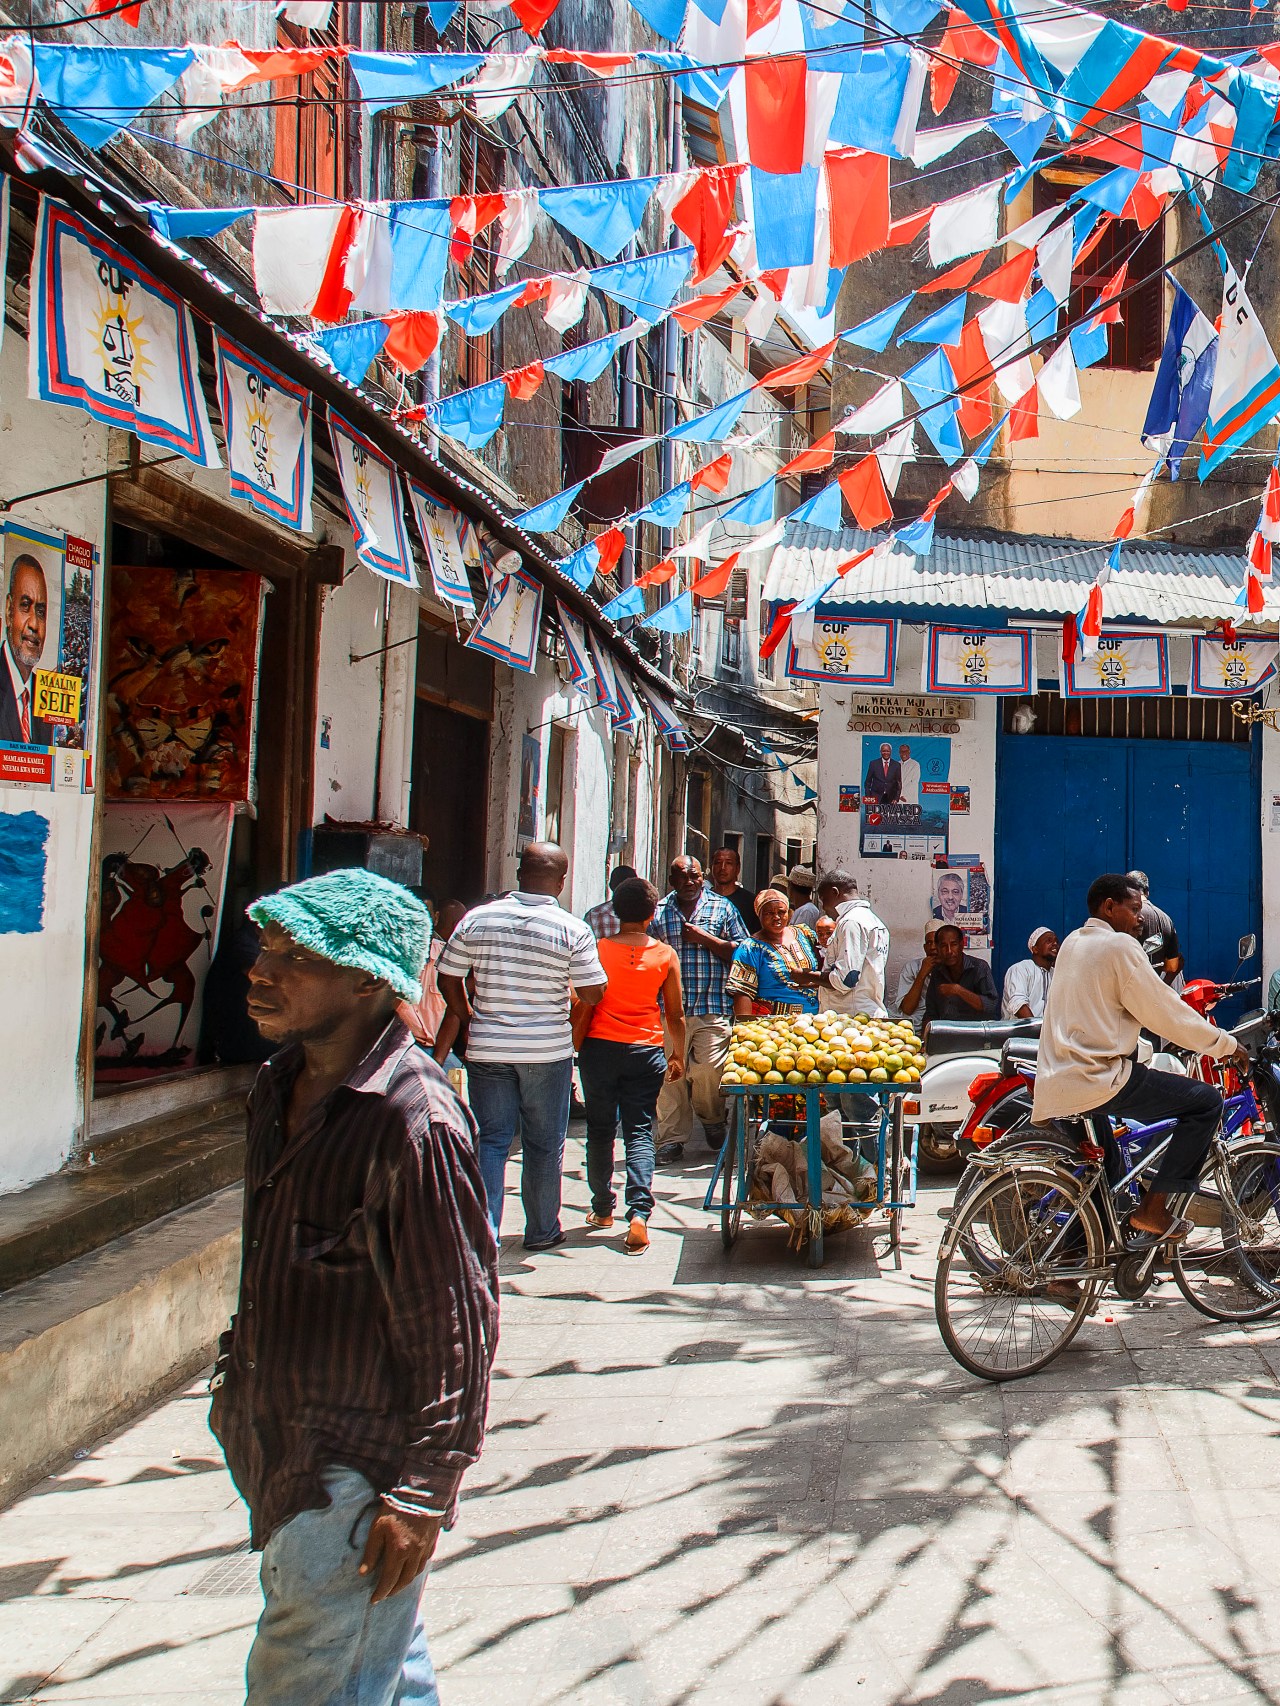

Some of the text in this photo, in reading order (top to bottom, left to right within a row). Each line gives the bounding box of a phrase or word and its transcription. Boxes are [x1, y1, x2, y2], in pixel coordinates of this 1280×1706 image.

[98, 260, 133, 300] CUF
[247, 372, 270, 403] CUF
[68, 542, 91, 558] CHAGUO
[822, 623, 849, 634] CUF
[963, 636, 986, 646] CUF
[1098, 641, 1122, 650] CUF
[1222, 641, 1246, 651] CUF
[40, 673, 77, 692] MAALIM
[40, 689, 77, 714] SEIF
[871, 697, 925, 707] WEKA MJI
[856, 705, 943, 717] MKONGWE SAFI
[847, 722, 882, 733] SOKO
[887, 723, 902, 733] YA
